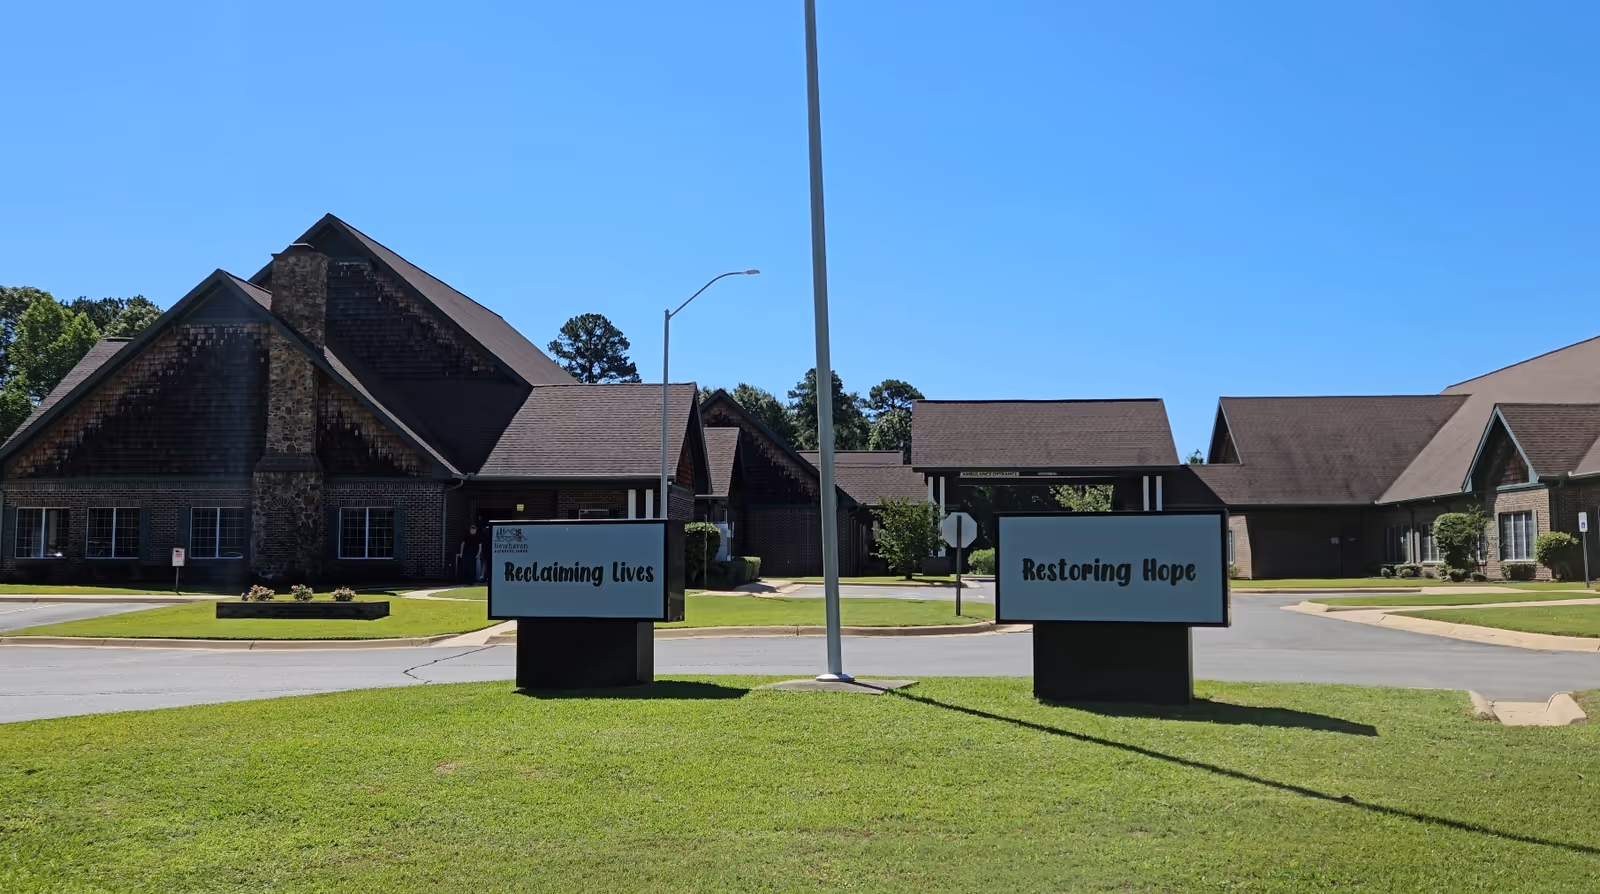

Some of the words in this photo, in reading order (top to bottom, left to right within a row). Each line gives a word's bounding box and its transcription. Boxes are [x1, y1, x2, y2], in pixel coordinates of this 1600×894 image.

[504, 561, 604, 587] Reclaiming
[612, 561, 654, 582] Lives
[1022, 558, 1131, 587] Restoring
[1142, 558, 1196, 586] Hope
